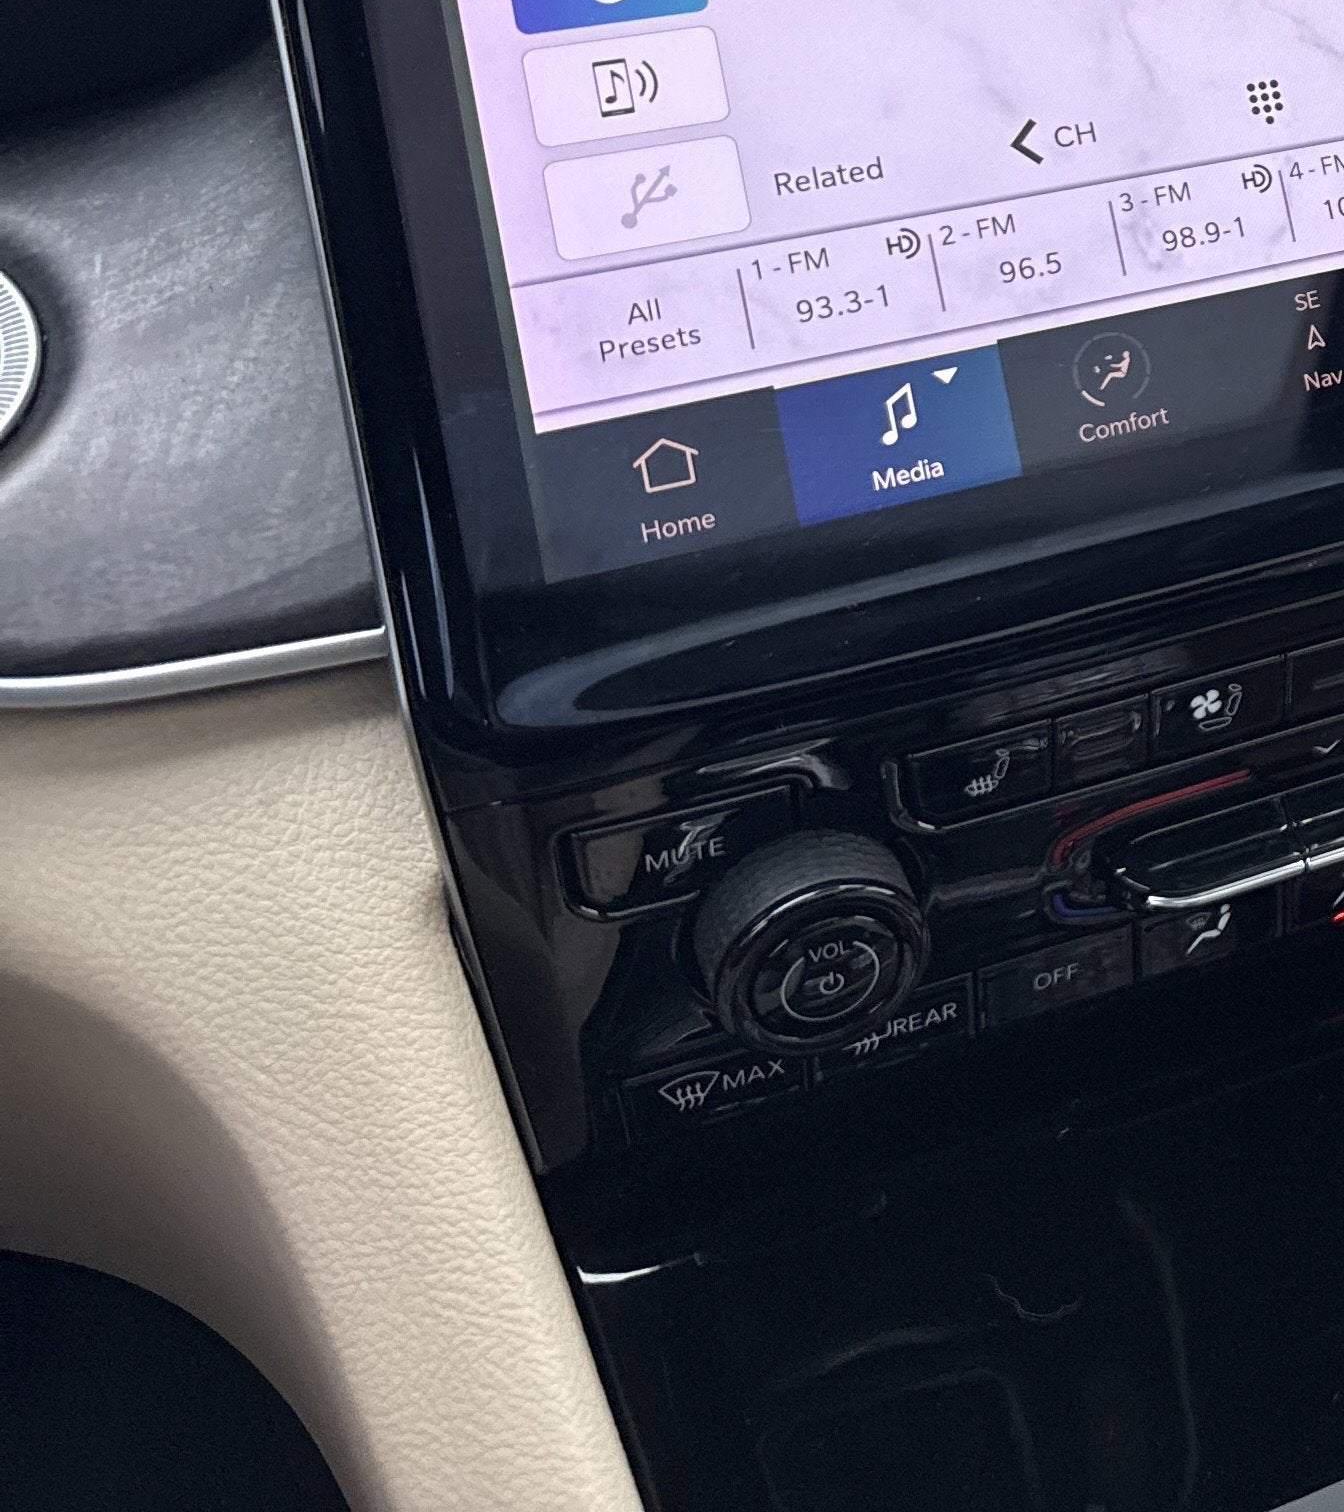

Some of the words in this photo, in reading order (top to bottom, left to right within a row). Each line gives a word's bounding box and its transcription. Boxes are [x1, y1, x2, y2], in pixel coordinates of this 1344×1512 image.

[1053, 121, 1098, 149] CH
[774, 157, 884, 197] Related
[1288, 161, 1305, 182] 4
[1119, 192, 1135, 213] 3
[1154, 181, 1192, 205] FM
[939, 226, 954, 247] 2
[975, 214, 1017, 239] FM
[1160, 216, 1247, 254] 98.9-1
[750, 260, 761, 281] 1
[787, 248, 830, 273] FM
[998, 252, 1064, 284] 96.5
[626, 297, 662, 326] All
[795, 285, 890, 324] 93.3-1
[1294, 290, 1320, 312] SE
[598, 324, 702, 364] Presets
[1303, 369, 1343, 391] Nav
[1079, 405, 1170, 445] Comfort
[872, 457, 945, 492] Media
[640, 509, 716, 544] Home
[644, 838, 728, 874] MUTE
[808, 940, 851, 963] VOL
[1033, 962, 1080, 990] OFF
[893, 1002, 958, 1037] REAR
[721, 1058, 786, 1092] MAX
